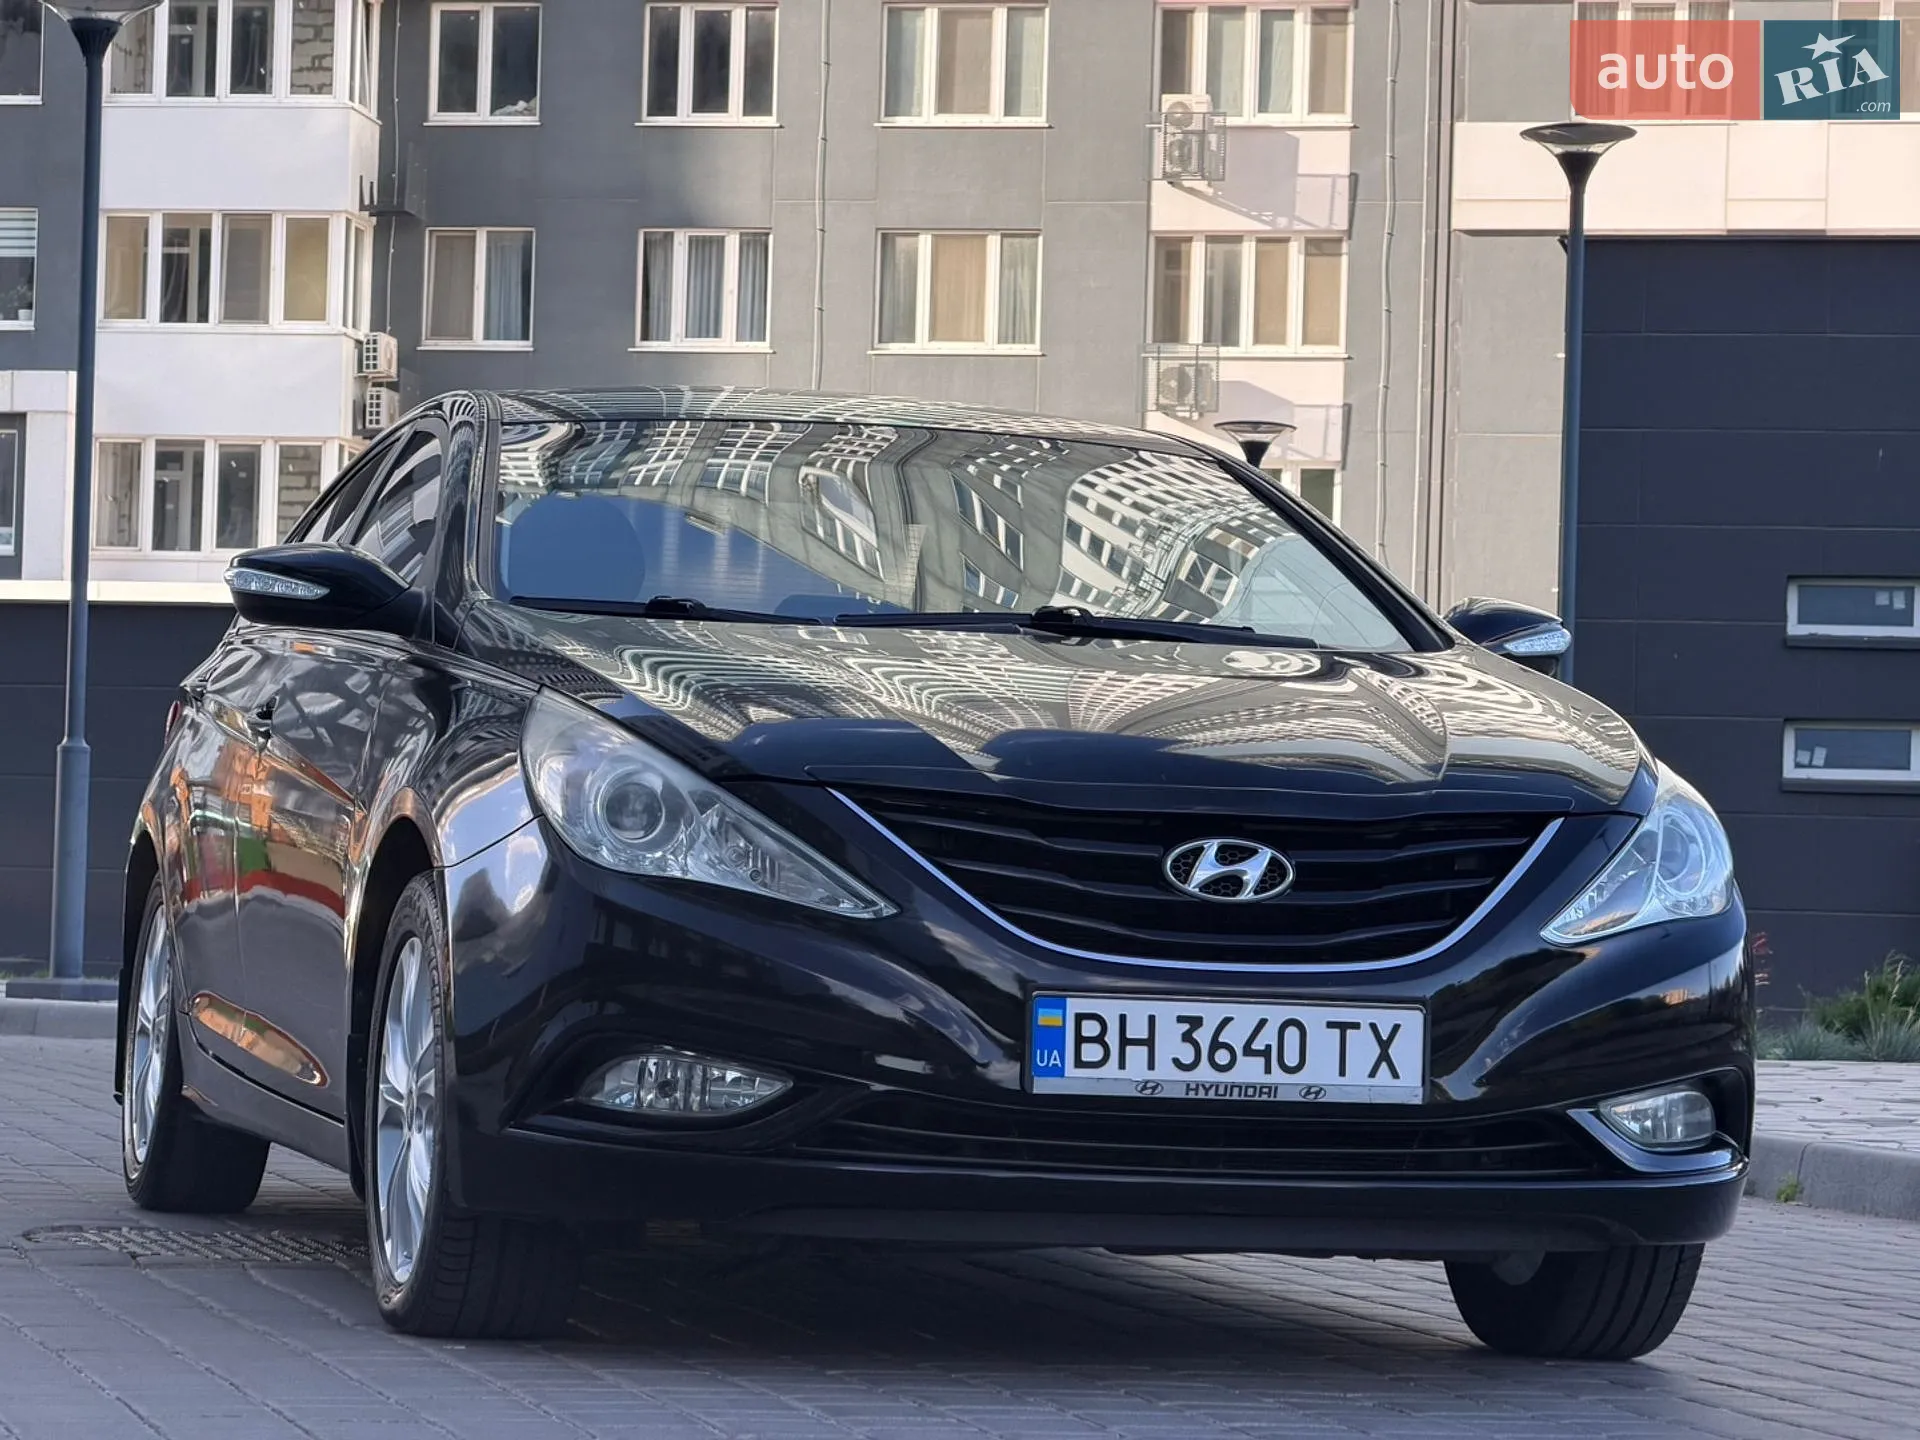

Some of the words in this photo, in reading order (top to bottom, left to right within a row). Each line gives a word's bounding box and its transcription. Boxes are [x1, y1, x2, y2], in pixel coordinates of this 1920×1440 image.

[1073, 1011, 1156, 1071] BH
[1171, 1015, 1307, 1076] 3640
[1326, 1020, 1401, 1079] TX
[1036, 1049, 1062, 1068] UA
[1184, 1082, 1279, 1100] HYUNDAI
